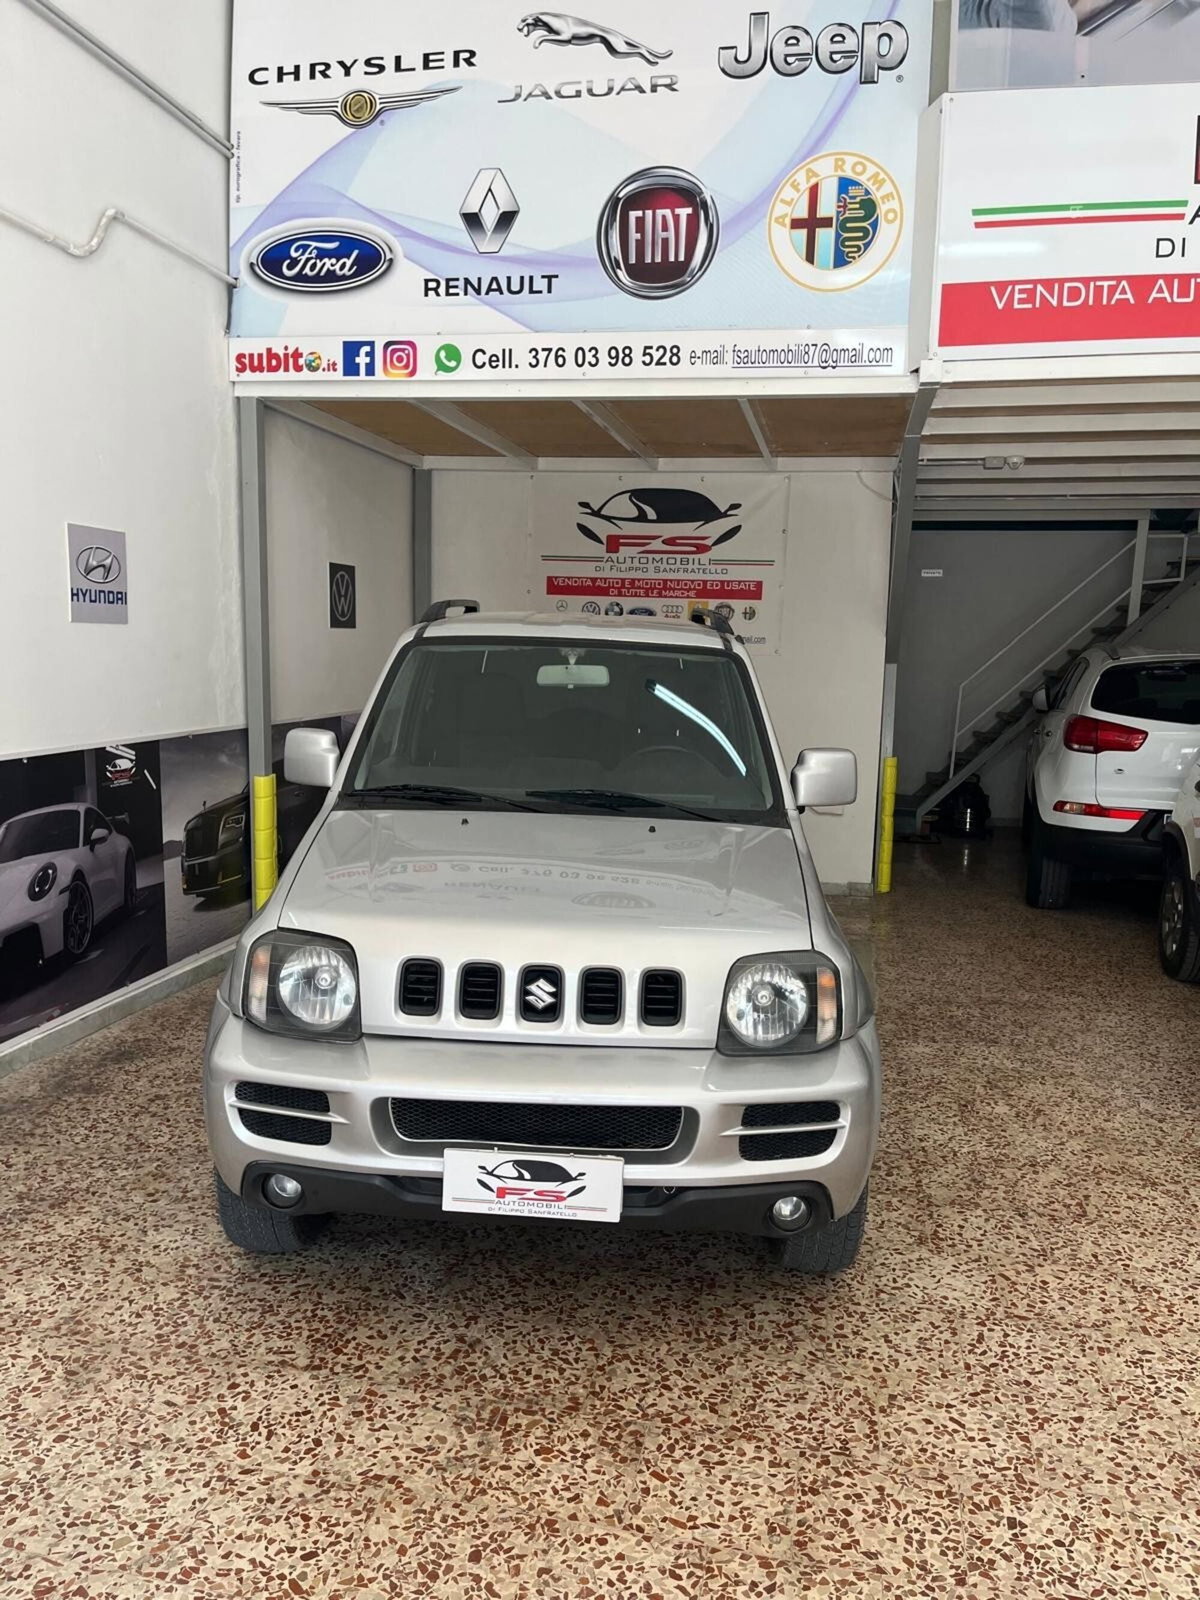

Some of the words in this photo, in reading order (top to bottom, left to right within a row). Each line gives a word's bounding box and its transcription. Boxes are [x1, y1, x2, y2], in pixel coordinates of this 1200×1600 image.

[718, 12, 909, 84] Jeep
[248, 49, 478, 86] CHRYSLER
[497, 74, 680, 103] JAGUAR
[773, 167, 820, 228] ALFA
[833, 157, 899, 225] ROMEO
[628, 207, 693, 264] FIAT
[1155, 237, 1187, 258] DI
[282, 240, 358, 278] Ford
[423, 274, 559, 298] RENAULT
[990, 280, 1135, 310] VENDITA
[1148, 278, 1200, 304] AU
[471, 348, 519, 369] Cell.
[528, 347, 567, 368] 376
[574, 346, 600, 368] 03
[607, 345, 634, 367] 98
[641, 345, 681, 367] 528
[689, 345, 728, 366] e-mail:
[731, 342, 894, 370] fsautomobili87@gmail.com
[606, 534, 712, 555] FS
[604, 556, 712, 566] AUTOMOBILI
[610, 565, 649, 574] FILIPPO
[653, 566, 729, 575] SANFRATELLO
[552, 577, 593, 587] VENDITA
[595, 579, 621, 587] AUTO
[624, 580, 632, 588] E
[634, 580, 664, 589] MOTO
[667, 581, 703, 590] NUOVO
[706, 582, 721, 590] ED
[724, 582, 757, 591] USATE
[621, 589, 645, 597] TUTTE
[70, 587, 128, 606] HYUNDAI
[495, 1200, 567, 1209] AUTOMOBILI
[496, 1187, 567, 1202] FS
